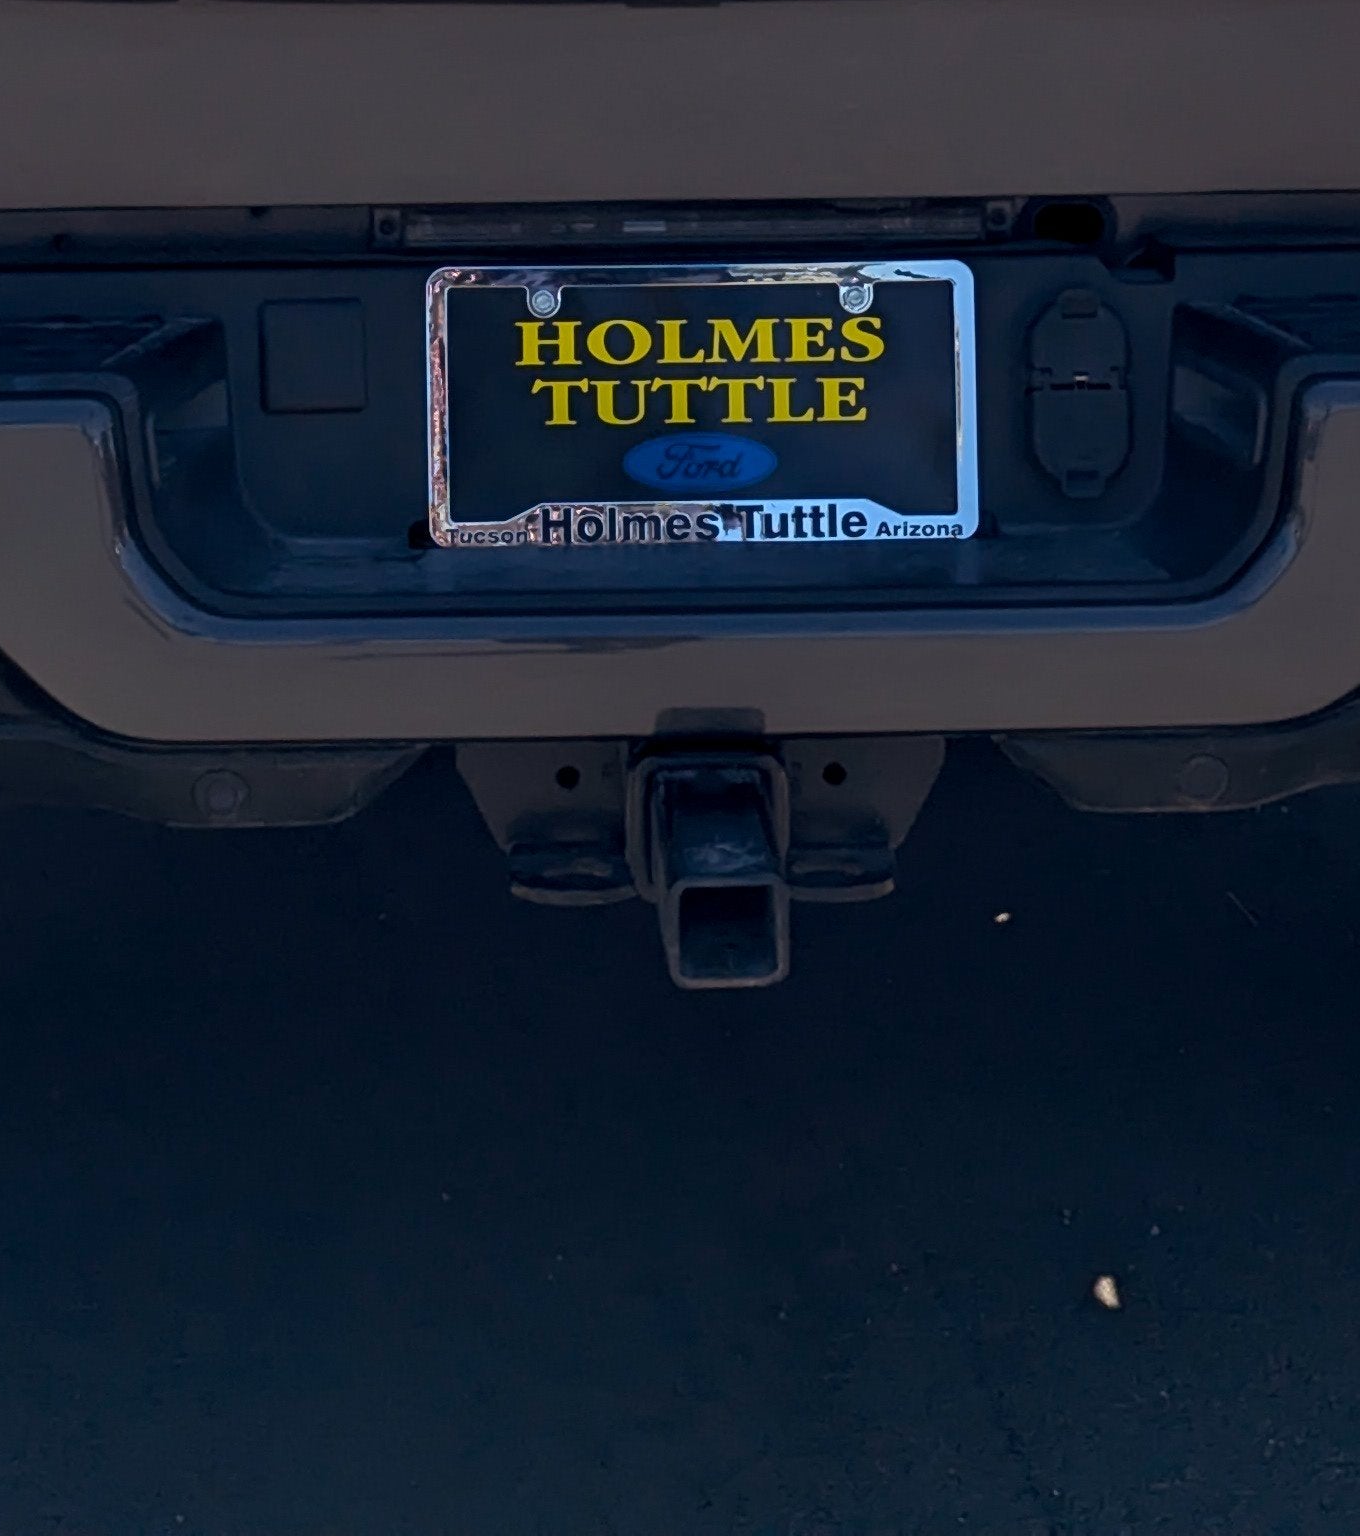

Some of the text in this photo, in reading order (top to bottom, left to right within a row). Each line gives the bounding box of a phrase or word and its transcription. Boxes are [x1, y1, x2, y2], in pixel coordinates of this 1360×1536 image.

[514, 316, 886, 367] HOLMES
[531, 375, 868, 427] TUTTLE
[656, 443, 744, 480] Ford
[446, 504, 965, 546] Tucson Holmes Tuttle Arizona
